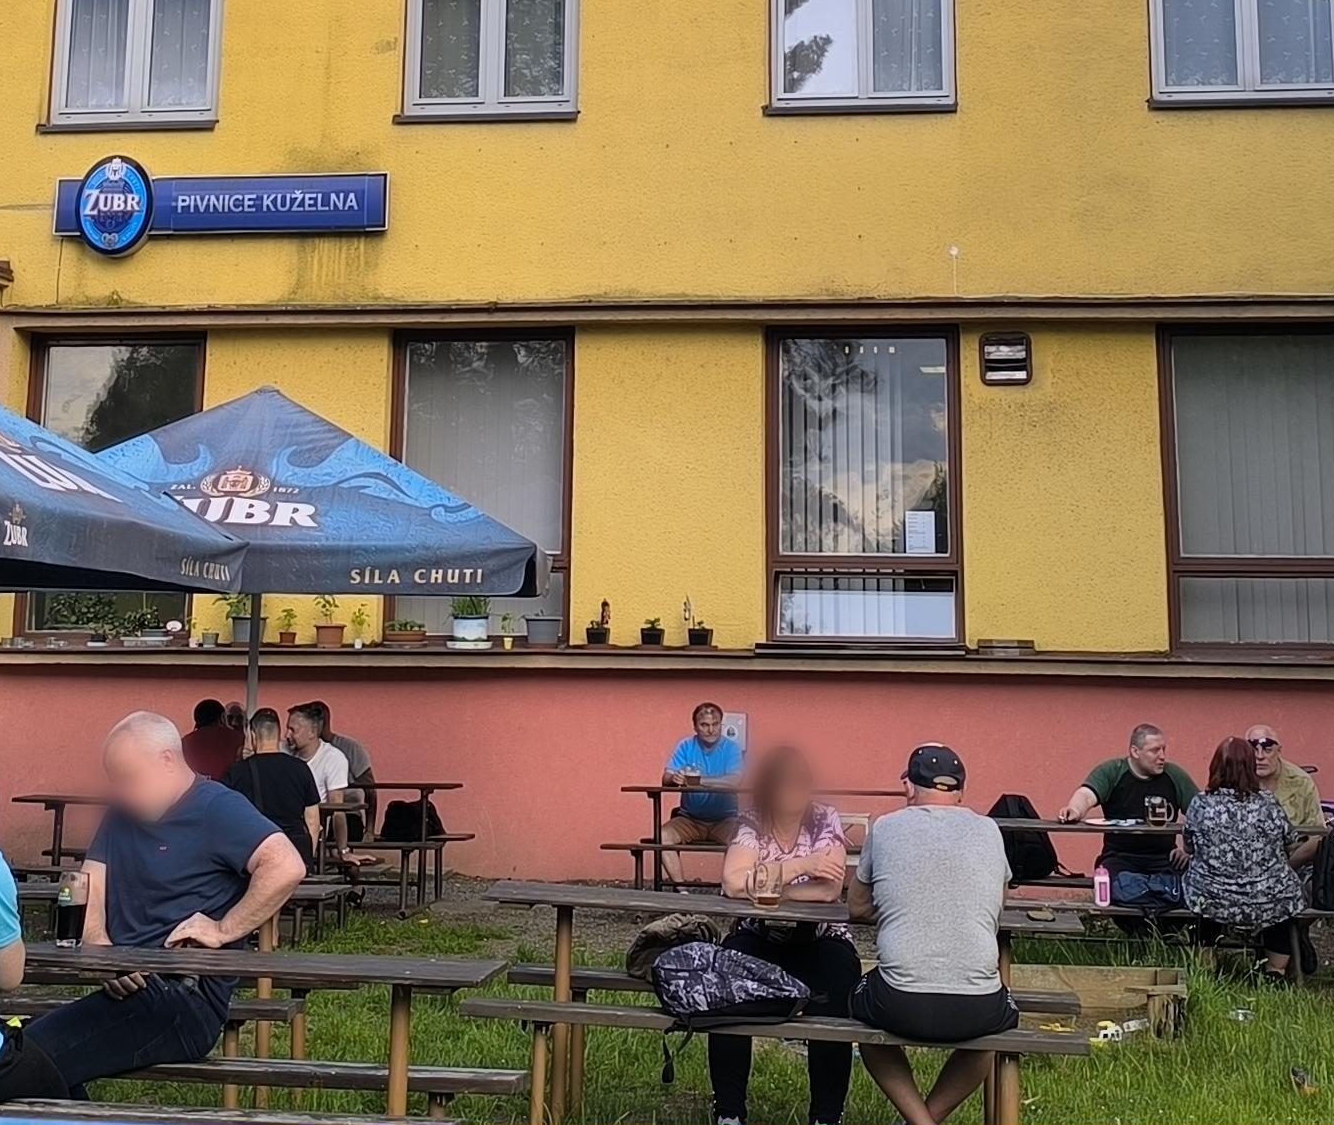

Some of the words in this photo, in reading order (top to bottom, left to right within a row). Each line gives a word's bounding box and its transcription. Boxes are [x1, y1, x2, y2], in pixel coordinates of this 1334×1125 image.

[83, 188, 140, 215] ZUBR
[176, 193, 257, 214] PIVNICE
[262, 189, 359, 213] KUŽELNA
[175, 496, 319, 527] UBR
[3, 520, 29, 547] ZUBR
[180, 556, 200, 578] SÍLA
[350, 566, 401, 584] SÍLA
[414, 568, 483, 584] CHUTI
